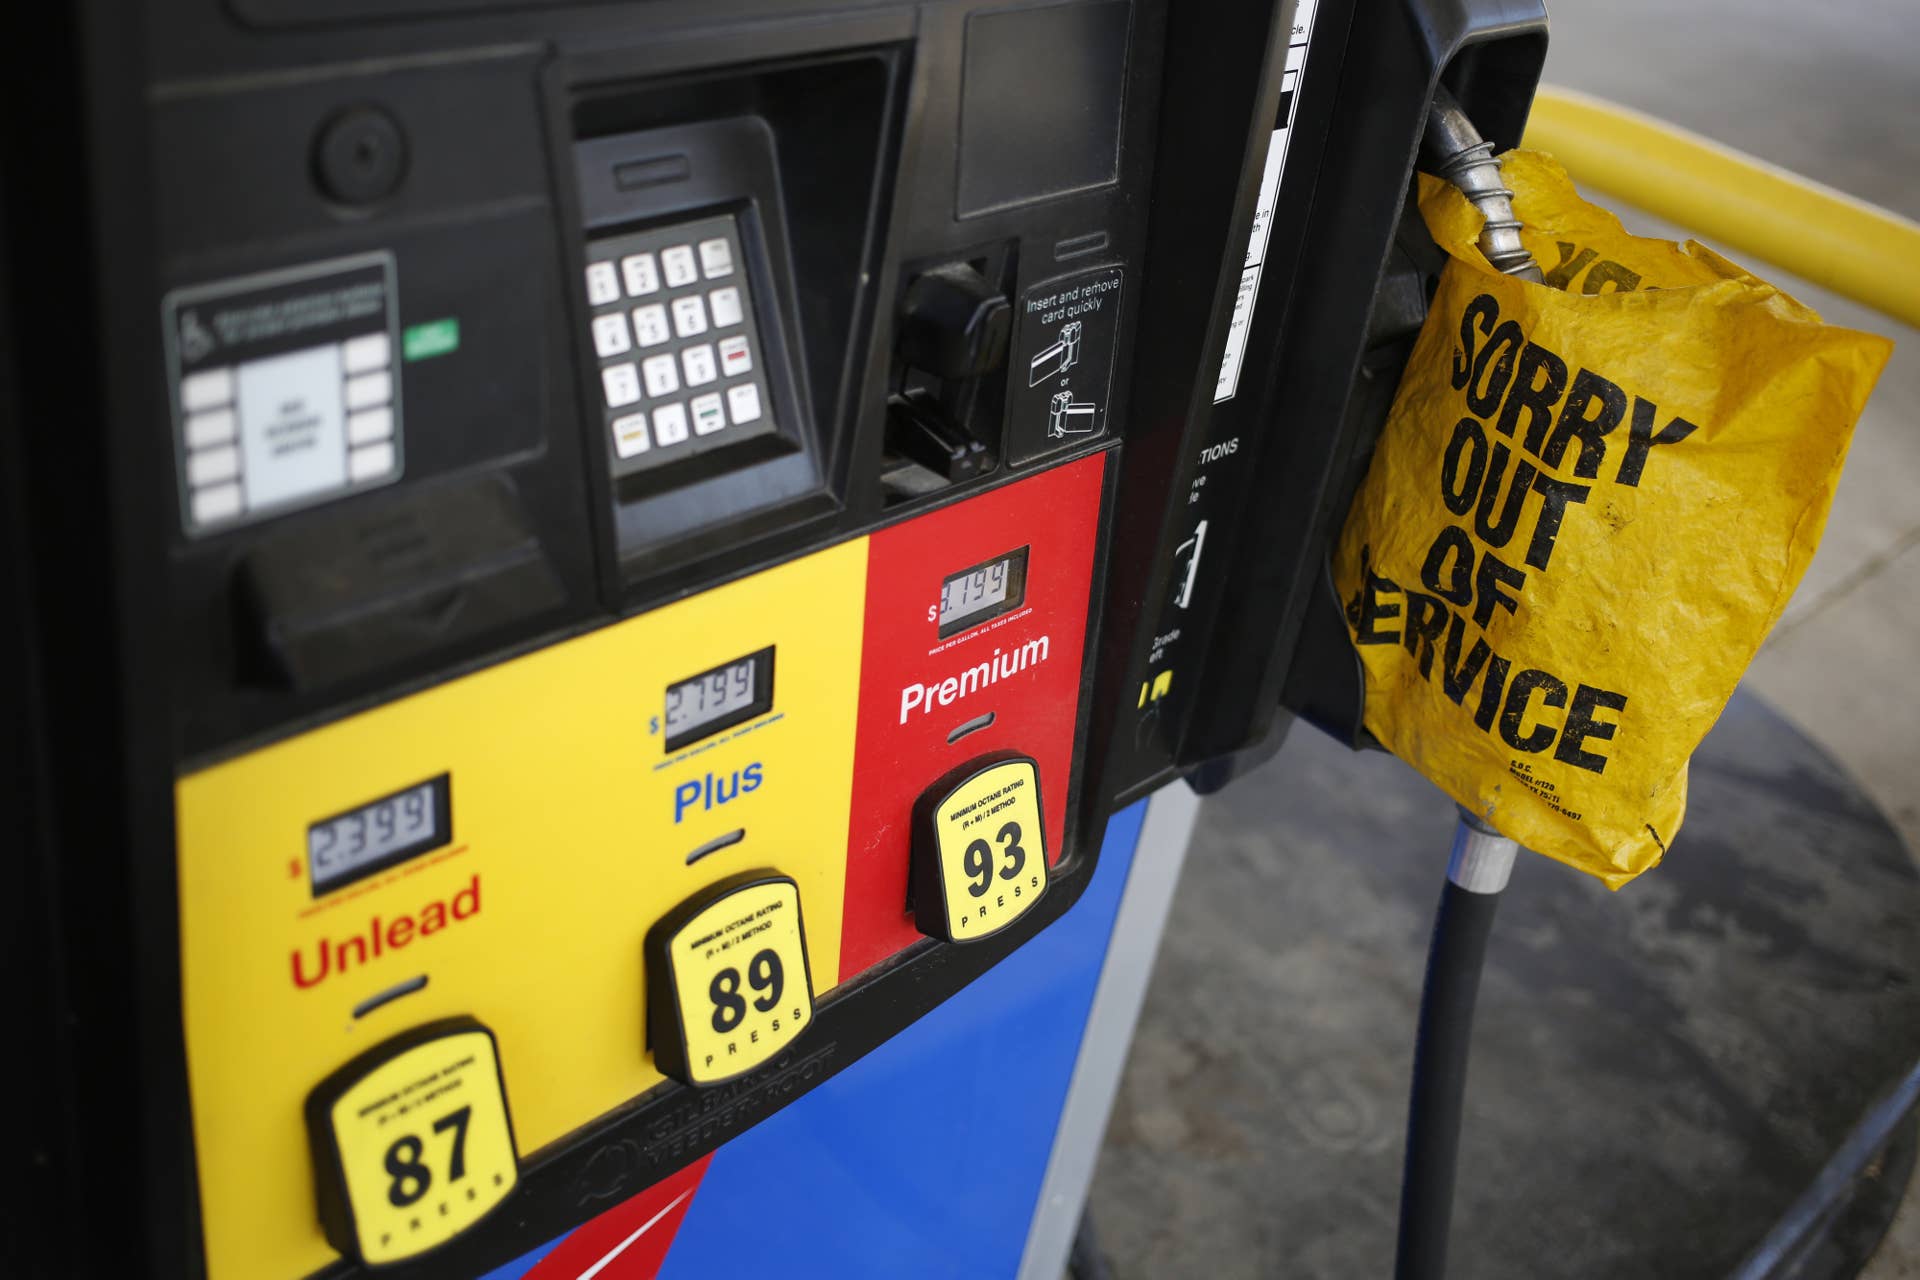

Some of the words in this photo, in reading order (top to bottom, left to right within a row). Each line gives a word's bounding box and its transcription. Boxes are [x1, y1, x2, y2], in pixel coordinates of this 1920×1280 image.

[1027, 294, 1057, 314] Insert
[1059, 287, 1079, 304] and
[1082, 278, 1120, 298] remove
[1042, 306, 1065, 324] card
[1066, 298, 1102, 318] quickly
[1060, 378, 1070, 386] or
[1452, 293, 1699, 487] SORRY
[1441, 417, 1592, 572] OUT
[1420, 525, 1527, 632] OF
[946, 640, 956, 650] PER
[980, 626, 990, 636] ALL
[1008, 607, 1032, 623] INCLUDED
[900, 634, 1049, 725] Premium
[674, 762, 763, 824] Plus
[950, 802, 977, 822] MINIMUM
[978, 790, 1002, 808] OCTANE
[1002, 778, 1024, 795] RATING
[990, 796, 1016, 815] METHOD
[963, 821, 1026, 898] 93
[291, 874, 480, 990] Unlead
[961, 876, 1038, 928] PRESS
[709, 948, 784, 1034] 89
[706, 1008, 802, 1068] PRESS
[384, 1104, 472, 1208] 87
